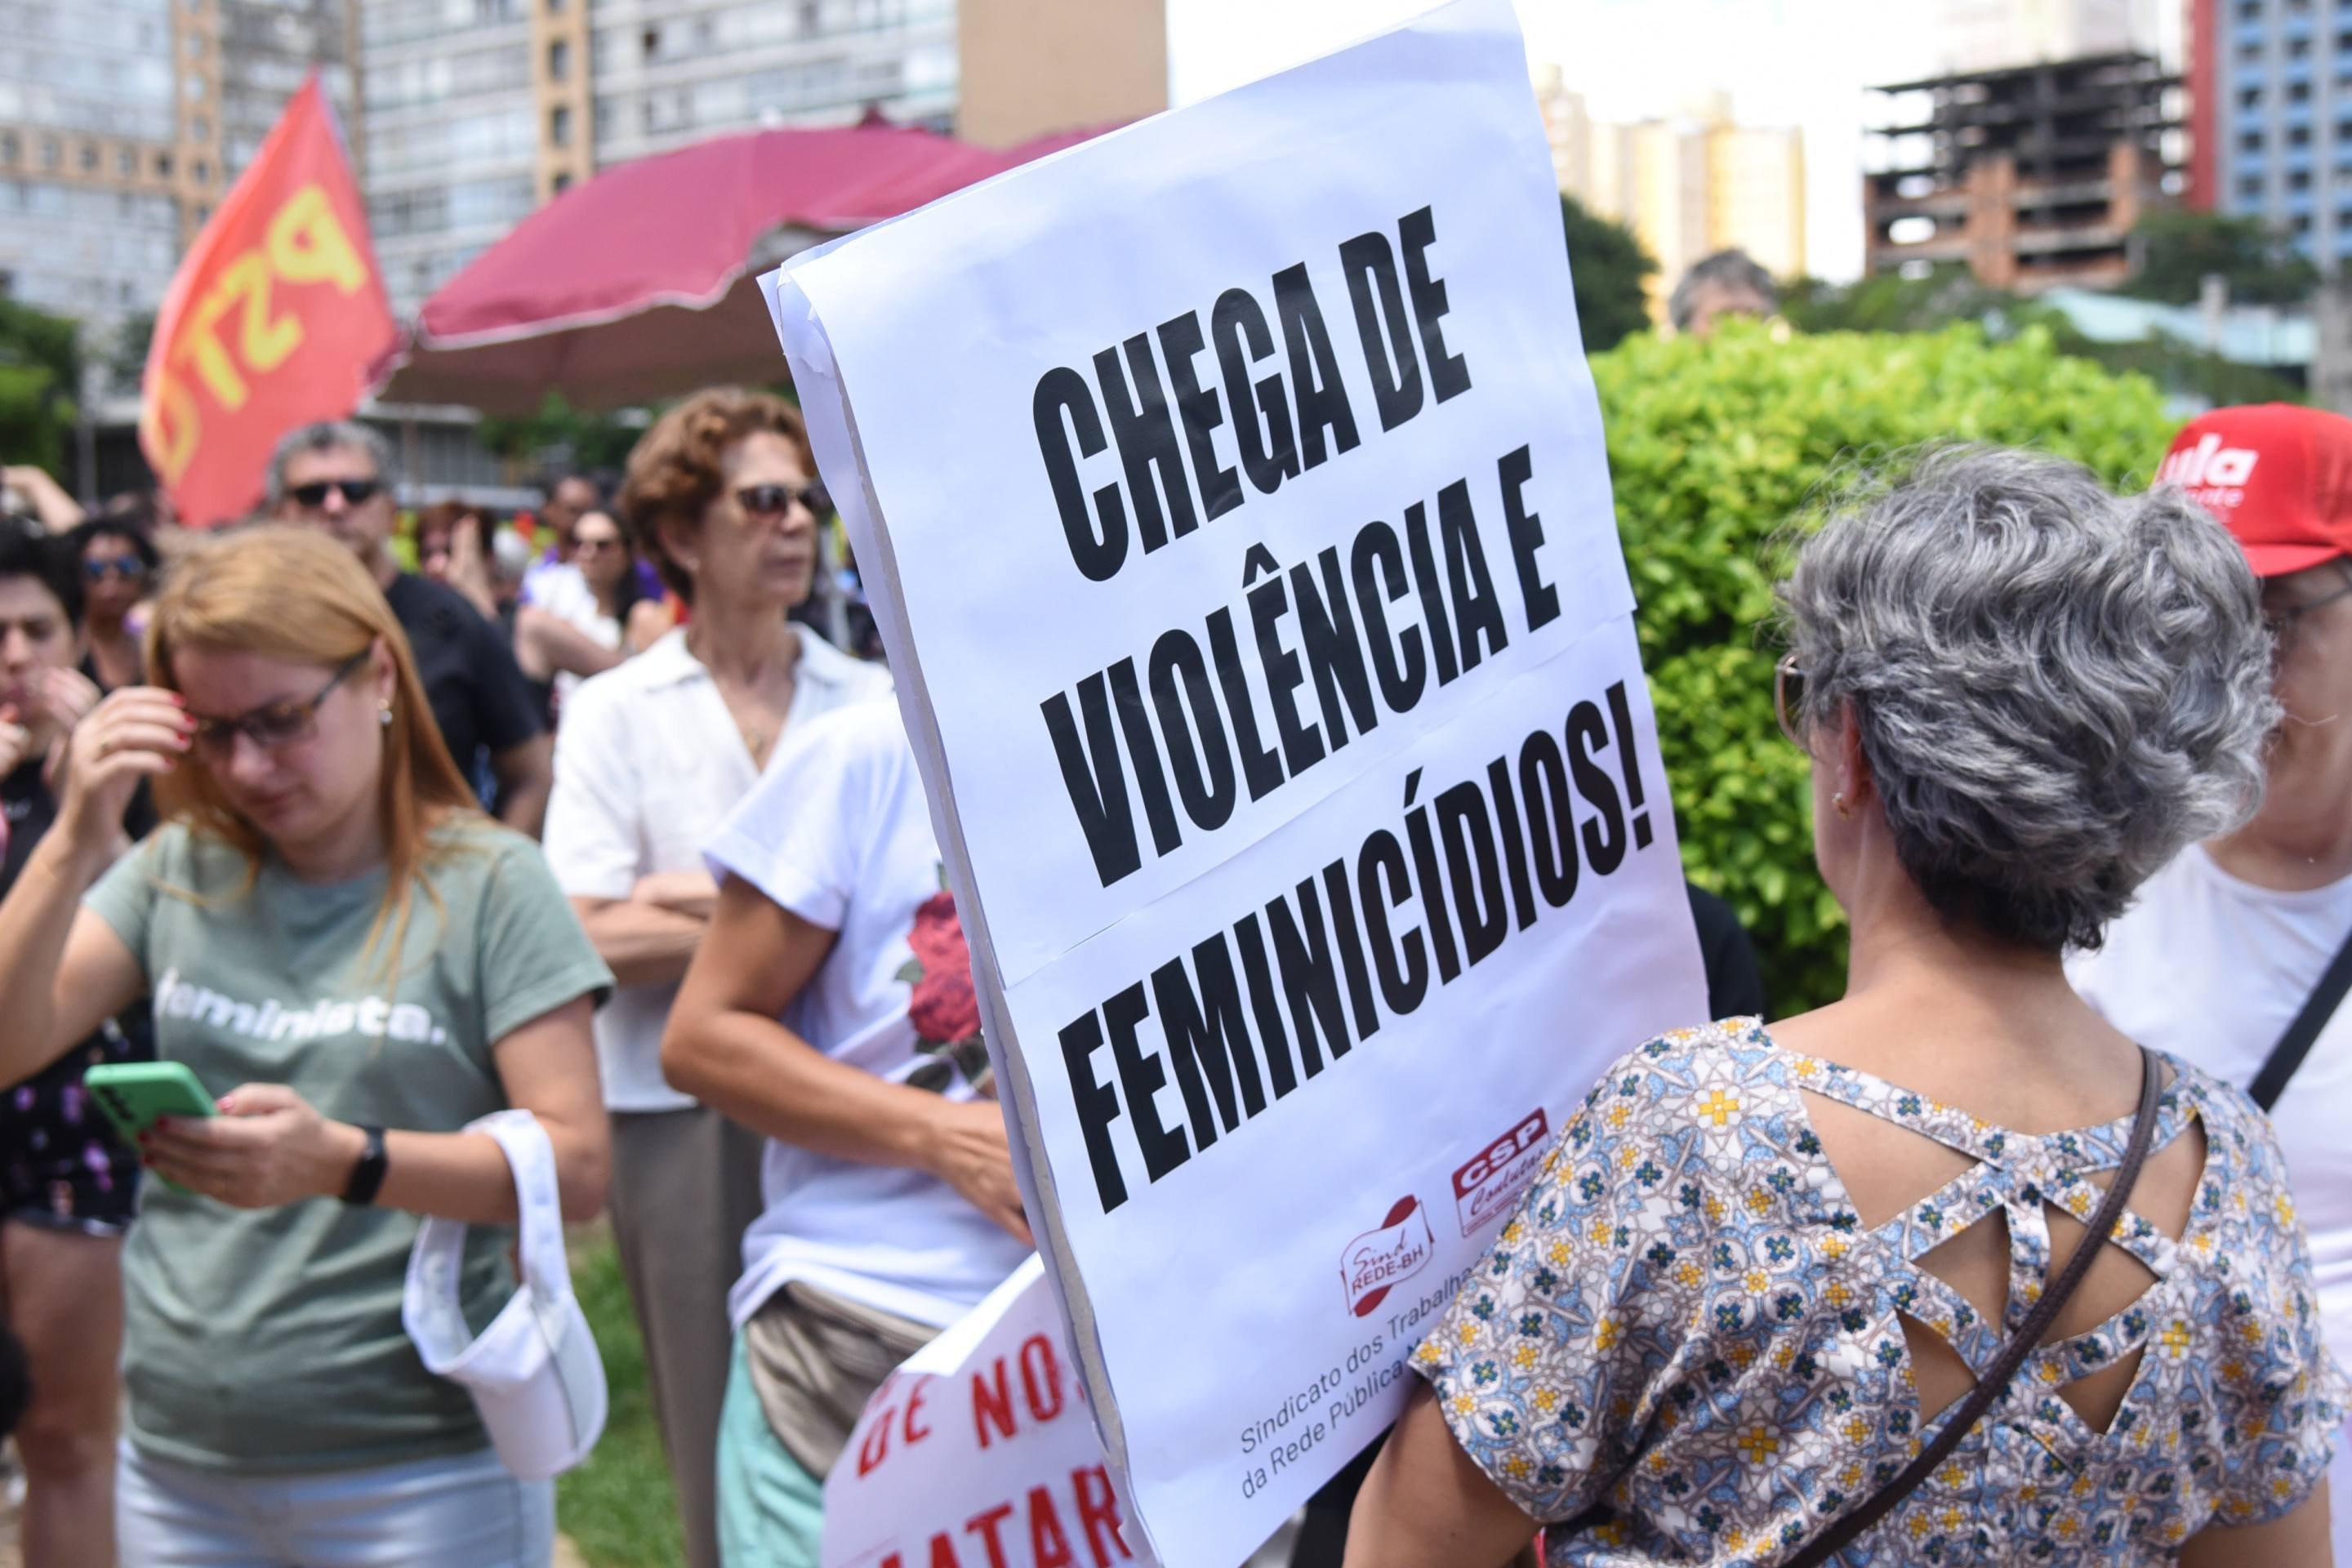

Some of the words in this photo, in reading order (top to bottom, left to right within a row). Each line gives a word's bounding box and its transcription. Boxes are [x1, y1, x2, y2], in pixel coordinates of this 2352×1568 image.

[1033, 261, 1361, 581] CHEGA
[1339, 204, 1472, 434] DE
[2161, 432, 2260, 487] ula
[1040, 476, 1509, 889] VIOLÊNCIA
[1498, 443, 1561, 634] E
[1058, 679, 1653, 1215] FEMINICÍDIOS!
[1460, 1118, 1543, 1190] CSP
[1352, 1227, 1406, 1277] Sind
[1352, 1243, 1424, 1295] REDE-BH
[971, 1332, 1085, 1449] NO
[1240, 1367, 1342, 1454] Sindicato
[1346, 1334, 1383, 1374] dos
[1241, 1467, 1267, 1499] da
[1270, 1420, 1325, 1475] Rede
[1329, 1359, 1404, 1429] Pública
